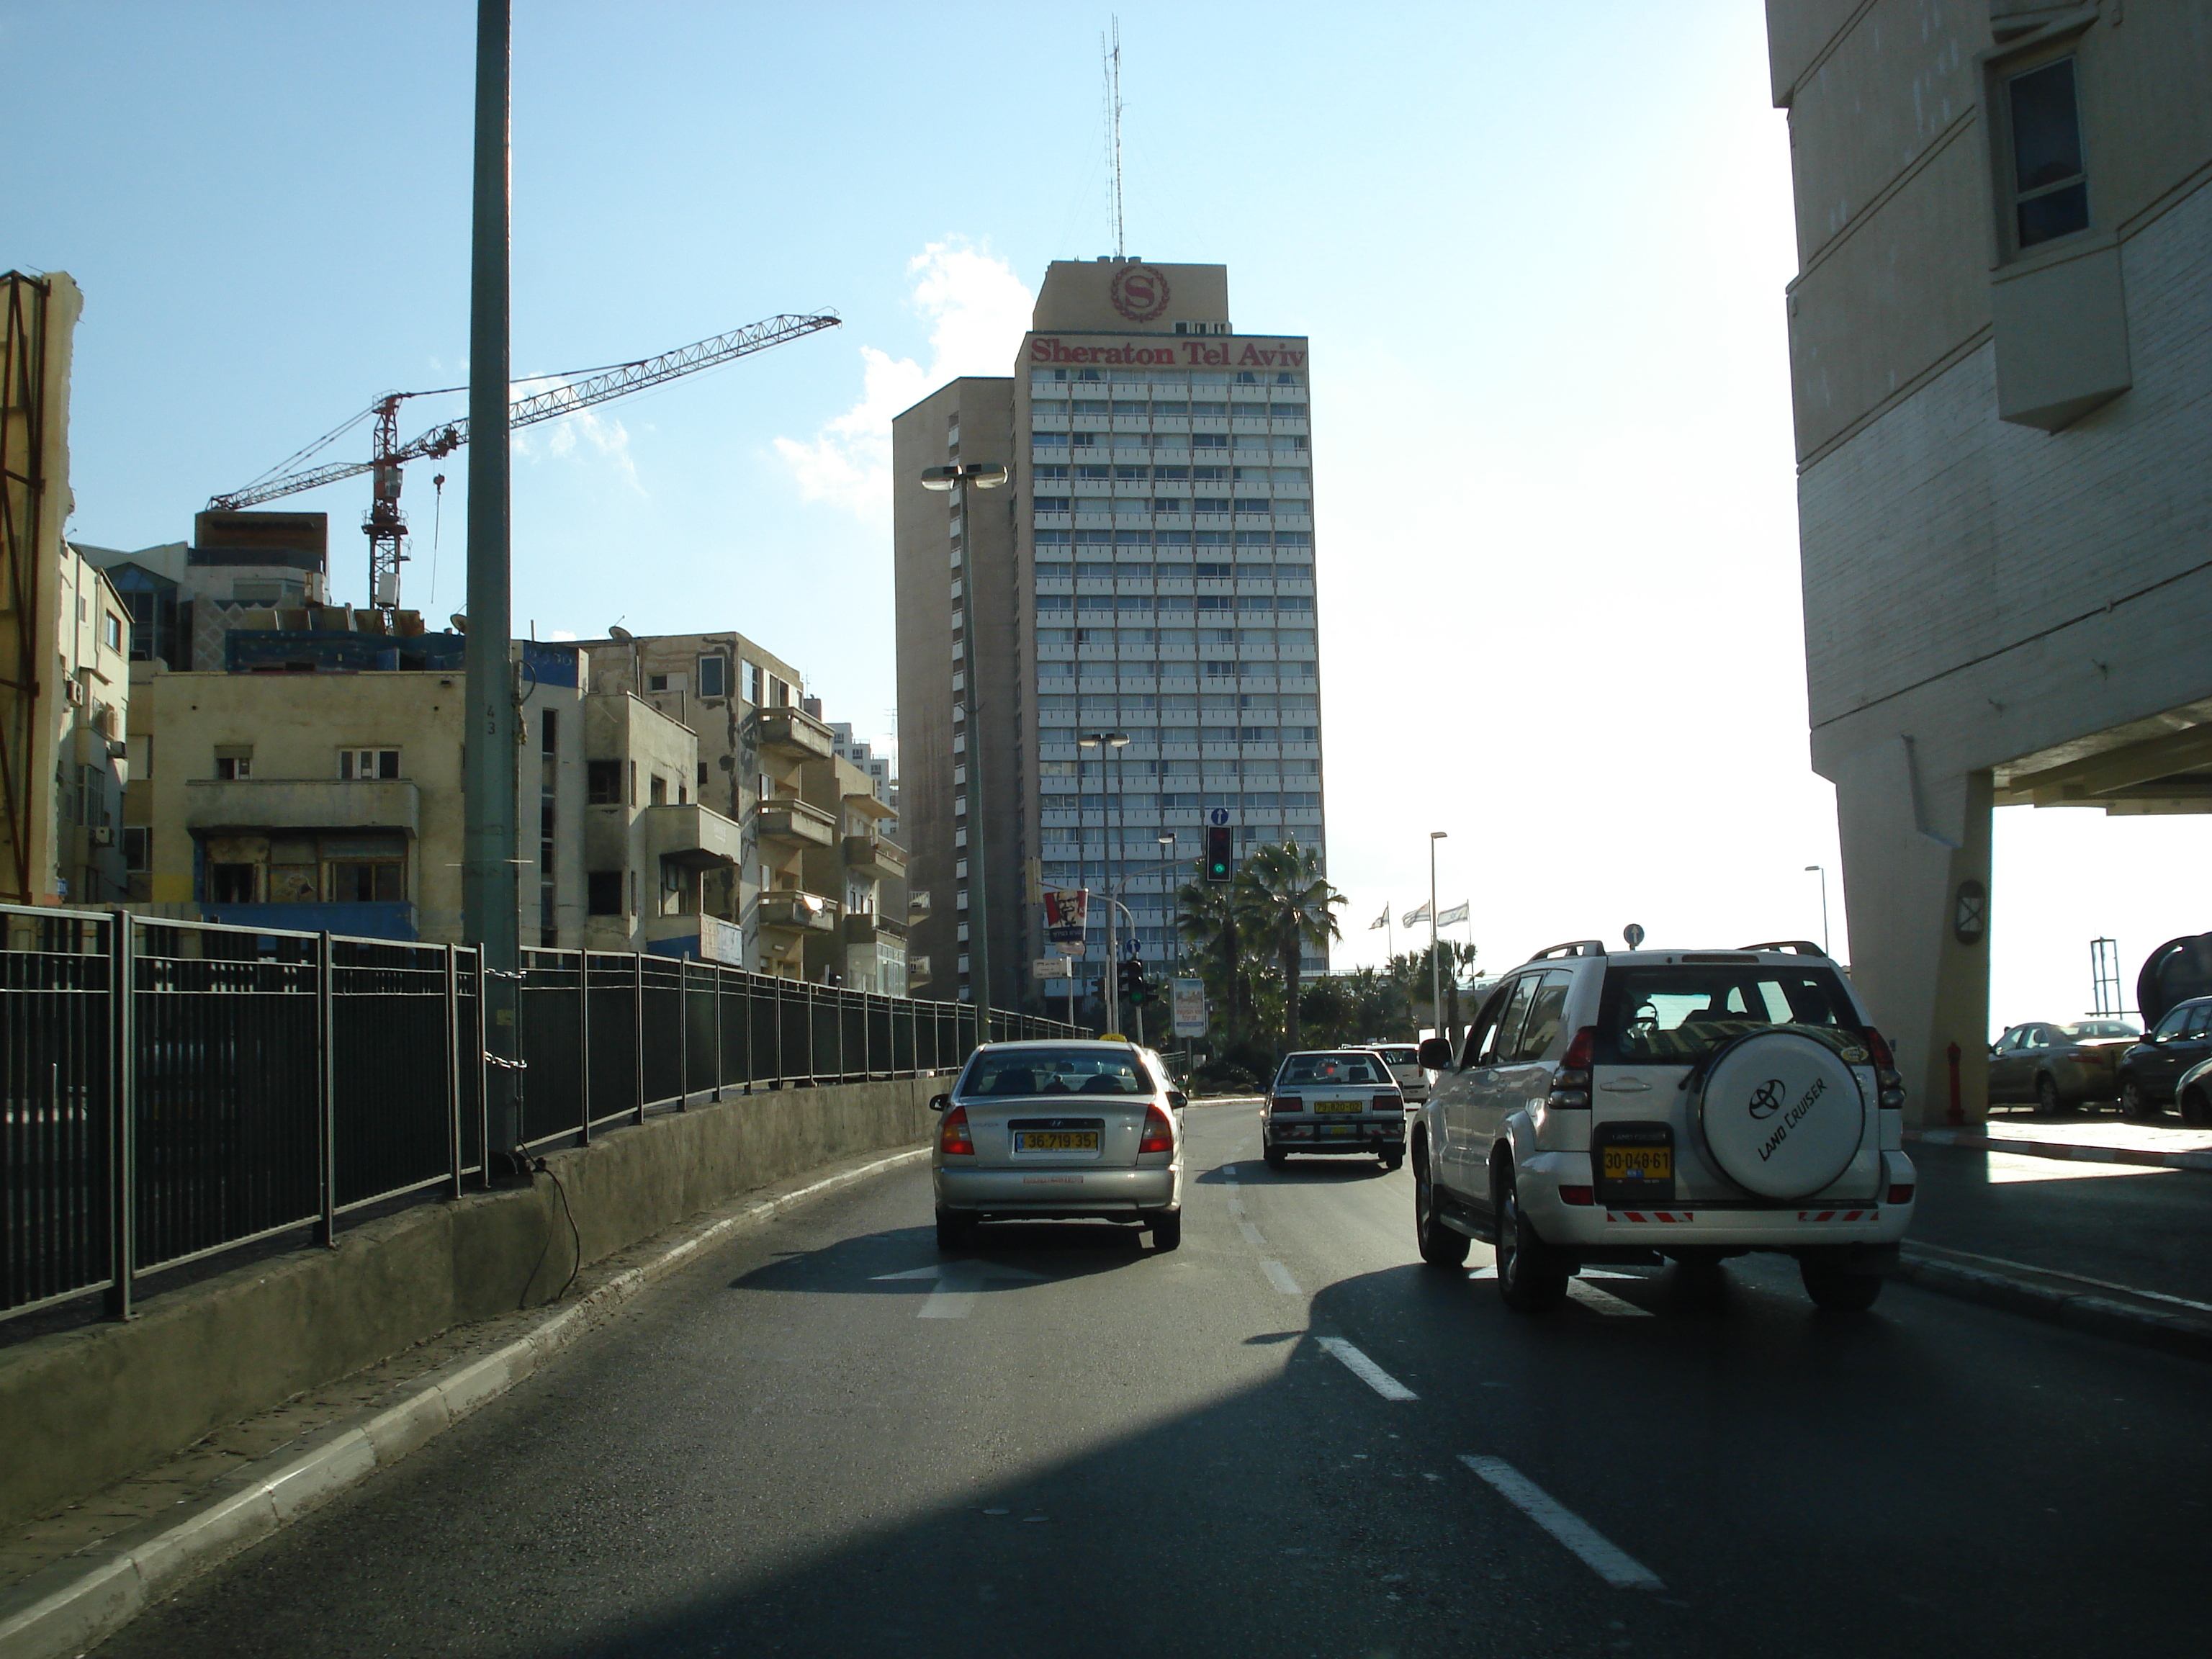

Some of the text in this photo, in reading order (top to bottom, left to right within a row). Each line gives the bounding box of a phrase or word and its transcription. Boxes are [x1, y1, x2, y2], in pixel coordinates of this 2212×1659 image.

[1123, 274, 1155, 309] S
[1030, 337, 1305, 367] Sheraton Tel Aviv
[1758, 1077, 1827, 1162] LAND CRUISER
